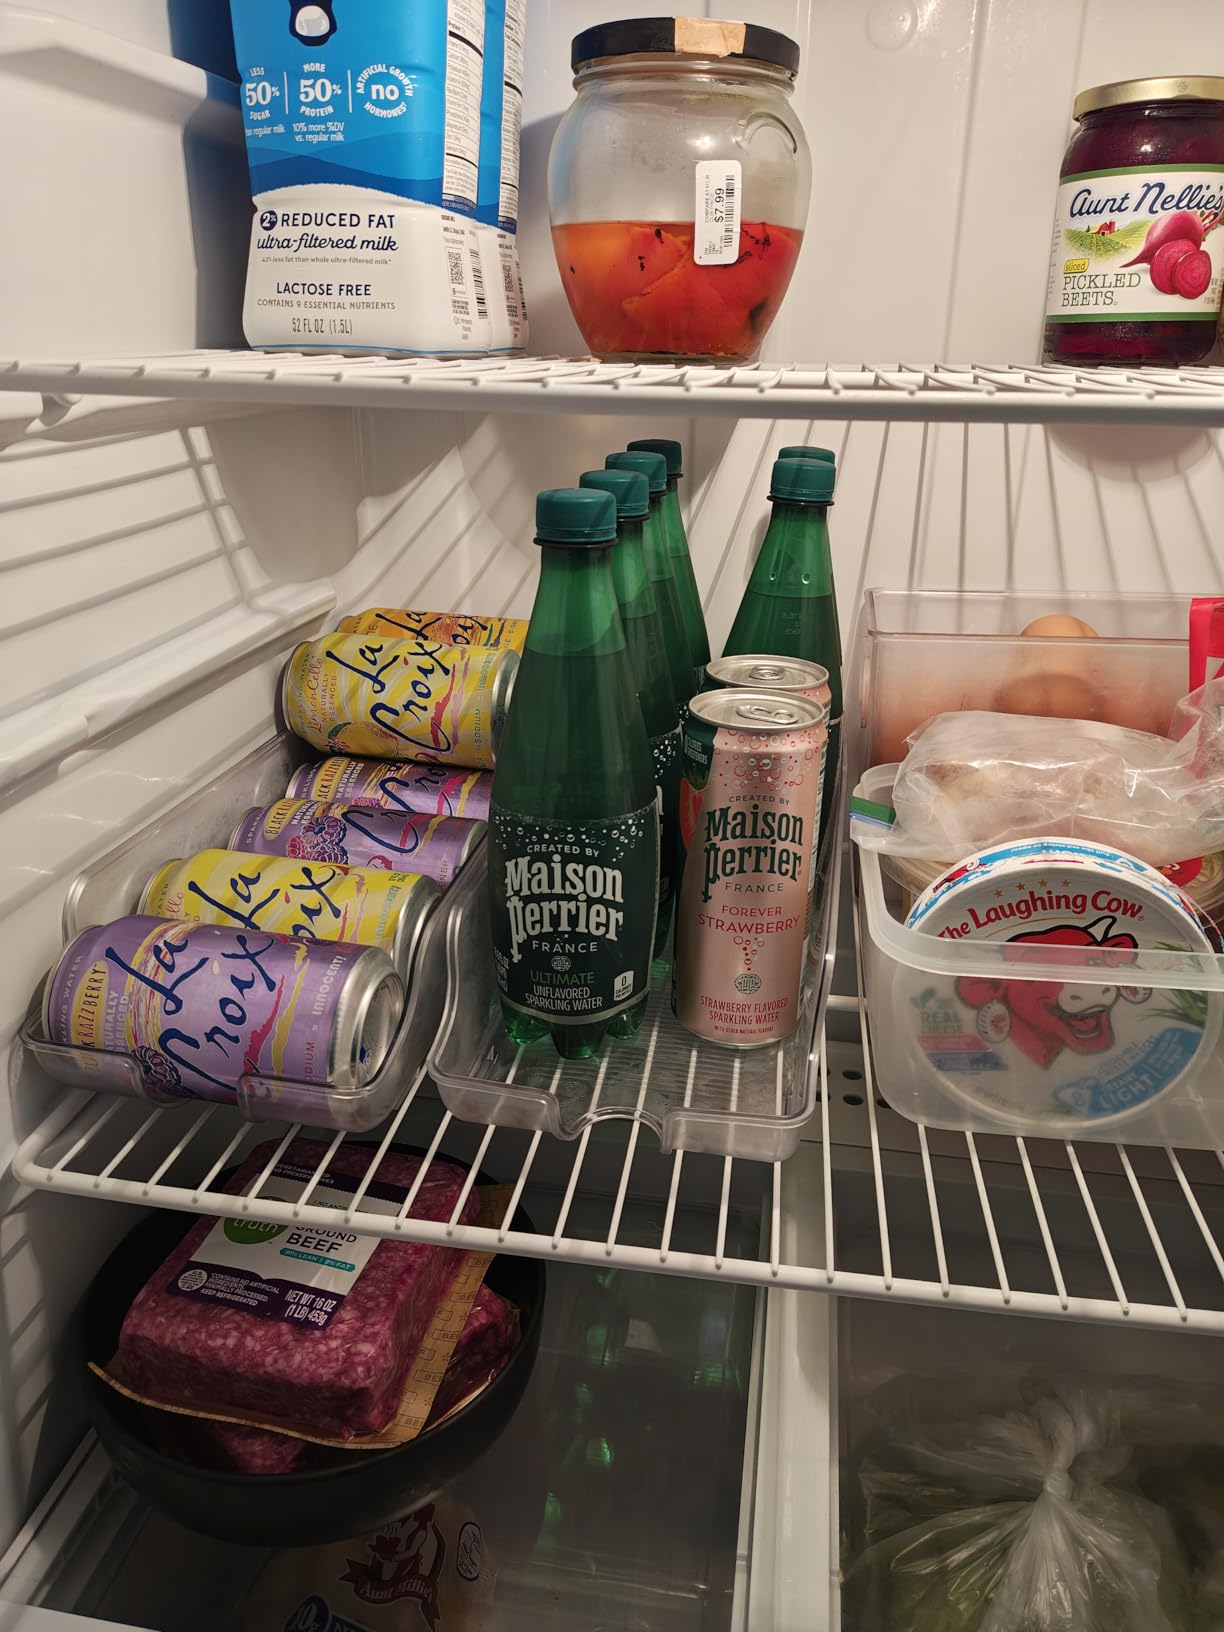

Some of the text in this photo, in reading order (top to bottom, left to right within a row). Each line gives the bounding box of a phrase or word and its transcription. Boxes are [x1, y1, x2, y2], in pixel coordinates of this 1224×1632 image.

[250, 67, 265, 77] LESS
[303, 63, 326, 73] MORE
[356, 64, 414, 97] ARTIFICIAL GROWTH
[245, 81, 280, 106] 50%
[300, 78, 342, 103] 50%
[371, 84, 400, 101] no
[250, 110, 271, 121] SUGAR
[300, 105, 334, 118] PROTEIN
[253, 124, 286, 138] regular milk
[293, 123, 307, 132] 10%
[308, 124, 325, 132] more
[306, 134, 329, 145] regular
[331, 133, 344, 142] milk
[714, 188, 725, 223] $7.99
[1070, 188, 1130, 218] Aunt
[281, 213, 360, 227] REDUCED
[368, 214, 395, 229] FAT
[257, 233, 399, 253] ultra-filtered milk
[330, 256, 374, 265] ultra-filtered
[1065, 261, 1087, 272] sliced
[276, 282, 372, 297] LACTOSE FREE
[1062, 273, 1141, 291] PICKLED
[257, 299, 396, 310] CONTAINS 9 ESSENTIAL NUTRIENTS
[292, 317, 353, 336] 52 FL OZ (1.5L)
[325, 643, 401, 695] La
[336, 761, 357, 799] NATURALLY
[728, 795, 790, 806] CREATED BY
[704, 803, 803, 847] Maison
[527, 844, 600, 858] CREATED BY
[505, 854, 624, 903] Maison
[725, 882, 784, 893] FRANCE
[722, 905, 782, 917] FOREVER
[967, 890, 1088, 928] Laughing
[1091, 890, 1143, 918] Cow
[698, 913, 800, 935] STRAWBERRY
[532, 940, 598, 954] FRANCE
[105, 938, 209, 1016] La
[530, 969, 595, 985] ULTIMATE
[621, 976, 627, 987] 0
[533, 984, 590, 999] UNFLAVORED
[525, 993, 603, 1011] SPARKLING WATER
[700, 995, 789, 1014] STRAWBERRY FLAVORED
[709, 1010, 780, 1025] SPARKLING WATER
[286, 1232, 342, 1254] BEEF
[298, 1251, 318, 1262] LEAN
[335, 1261, 351, 1270] FAT
[204, 1282, 234, 1294] MINIMALLY
[249, 1281, 280, 1295] ARTIFICIAL
[200, 1287, 259, 1306] KEEP REFRIGERATED
[284, 1289, 337, 1312] NET WT 16 OZ
[292, 1305, 308, 1320] LB)
[306, 1311, 328, 1327] 453g
